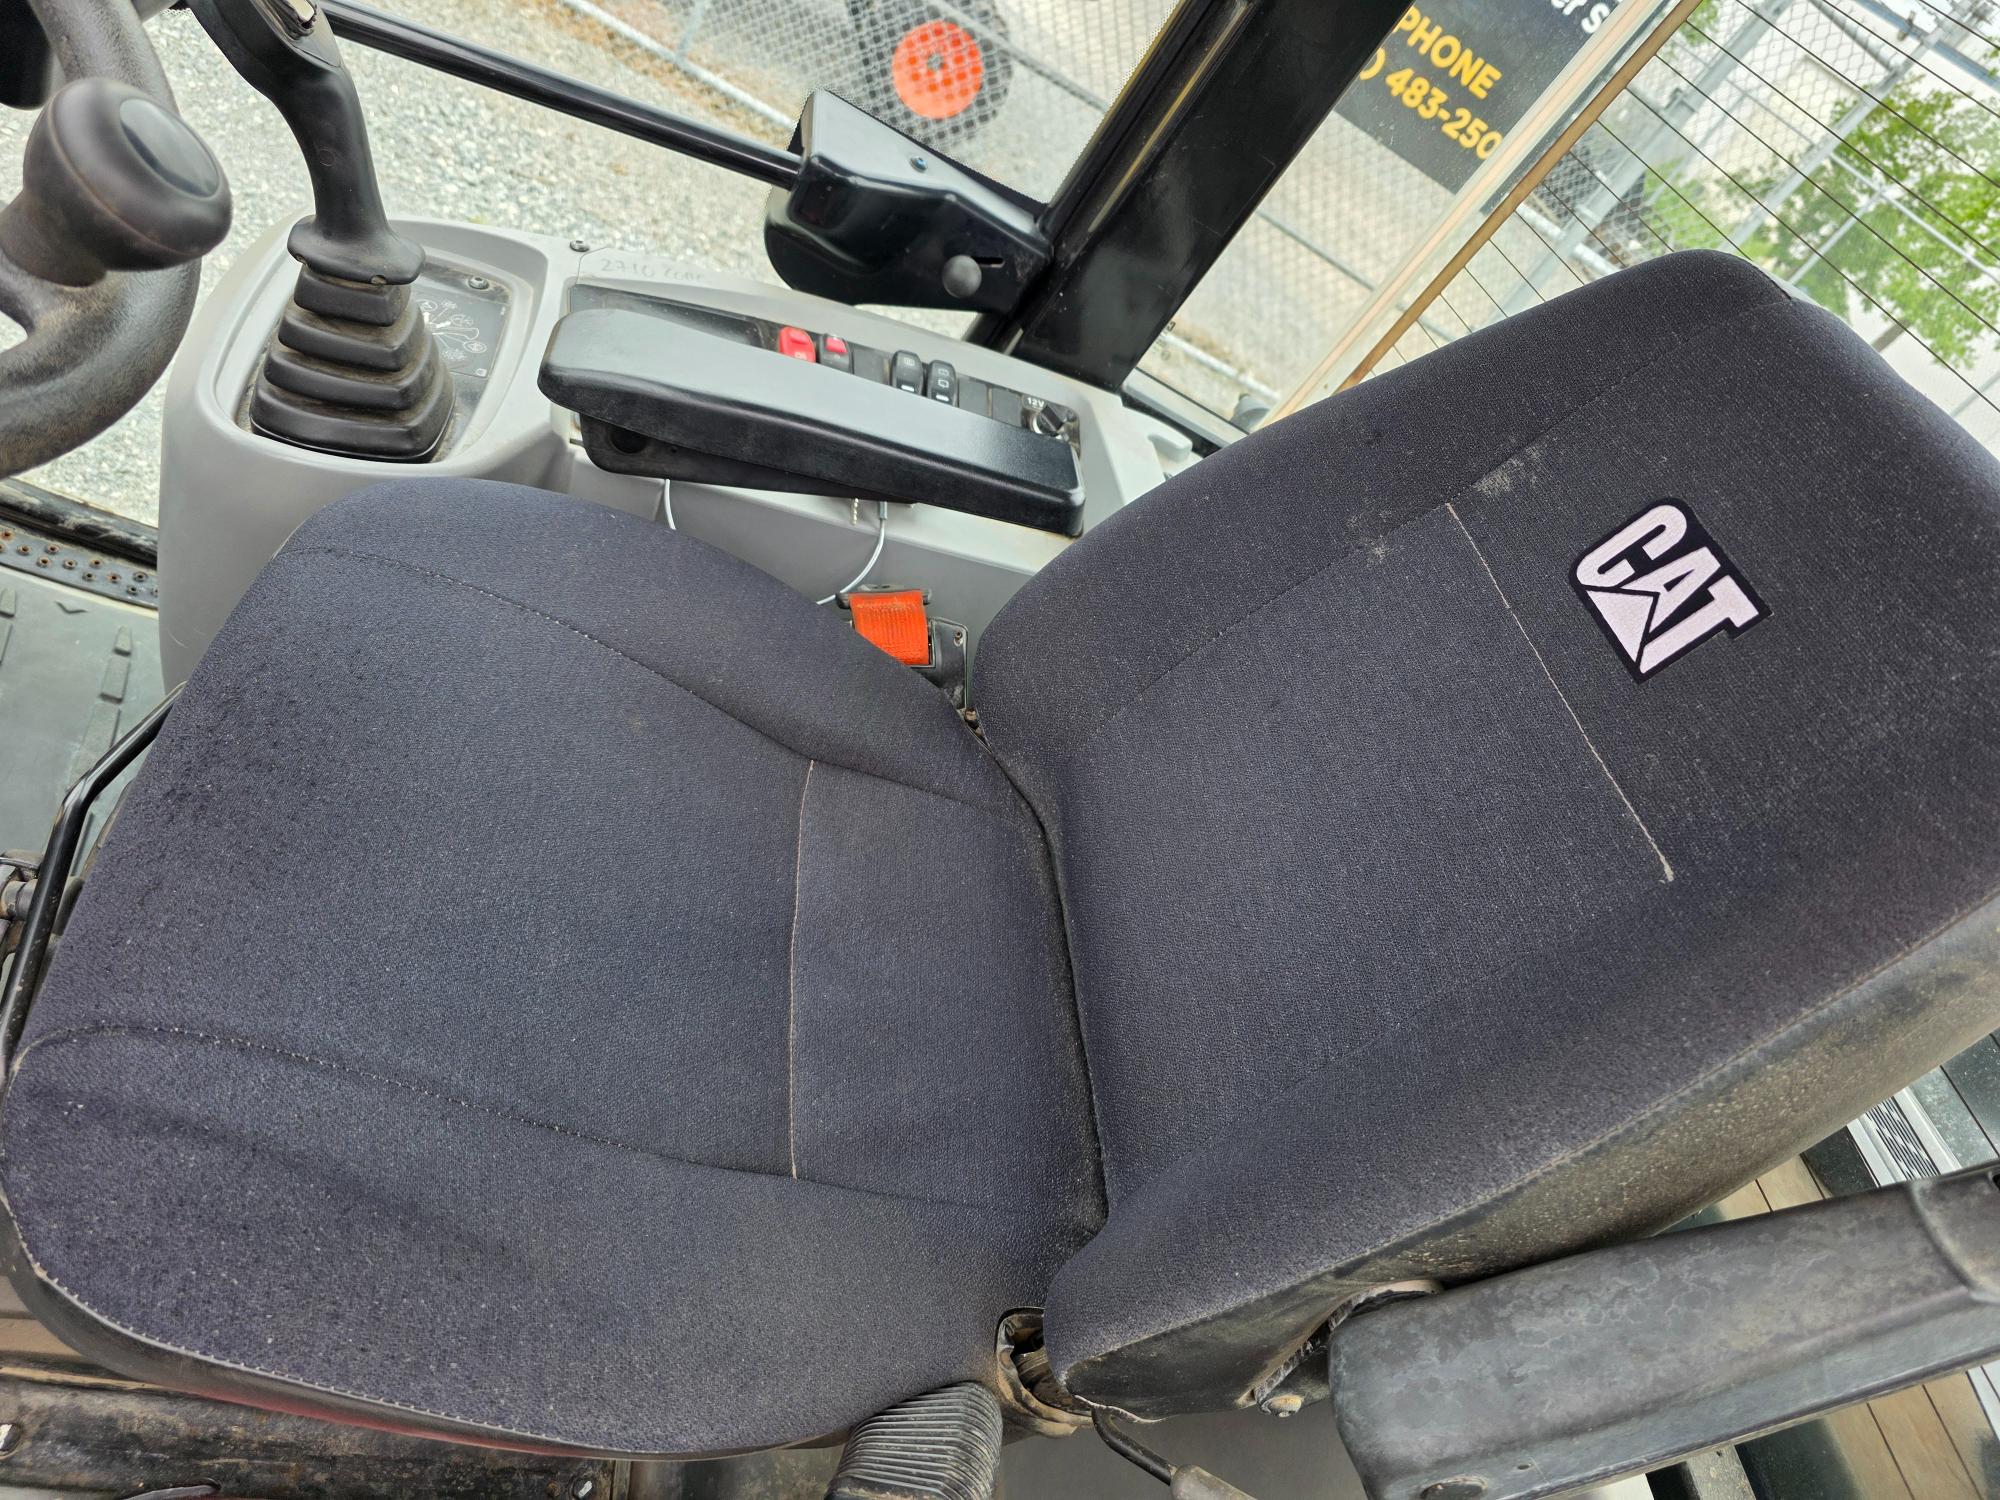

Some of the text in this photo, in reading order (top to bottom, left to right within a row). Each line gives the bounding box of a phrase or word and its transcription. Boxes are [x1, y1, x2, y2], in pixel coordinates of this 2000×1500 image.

[1392, 5, 1502, 99] PHONE
[1385, 68, 1503, 160] 483-250
[1026, 397, 1045, 408] 12V
[1576, 504, 1760, 675] CAT
